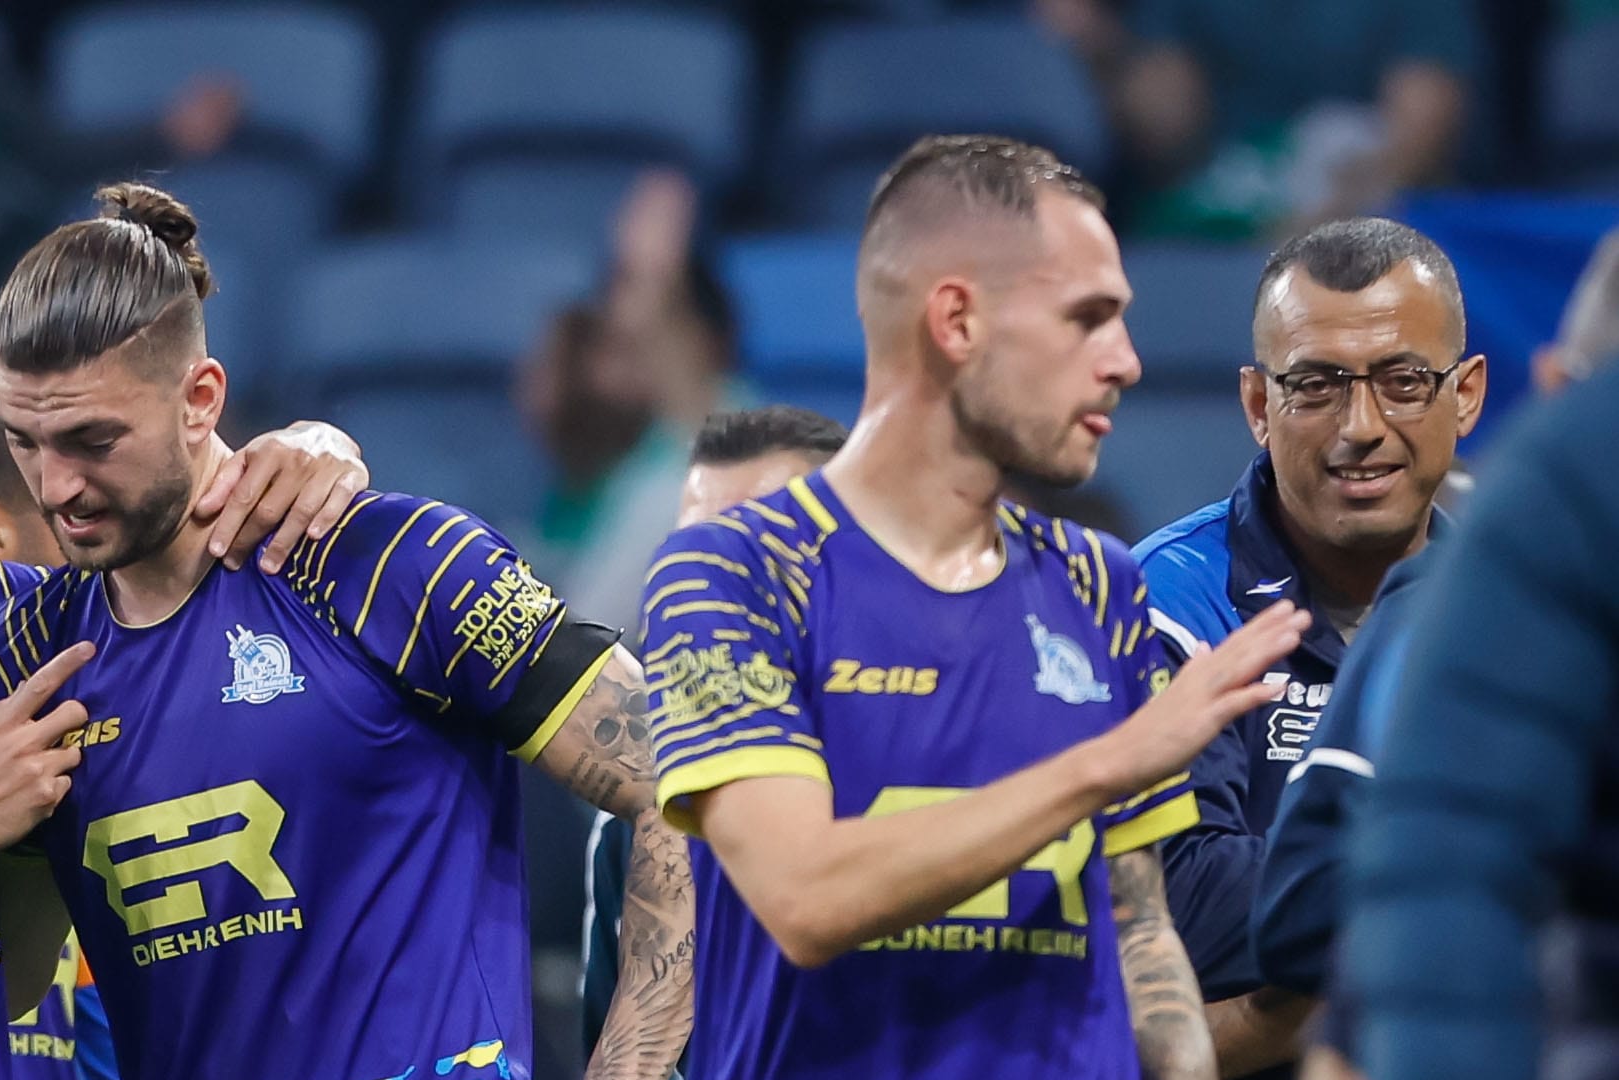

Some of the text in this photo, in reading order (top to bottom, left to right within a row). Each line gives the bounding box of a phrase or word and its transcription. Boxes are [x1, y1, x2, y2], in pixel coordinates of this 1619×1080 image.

[454, 566, 522, 639] TOPLINE
[823, 659, 939, 696] Zeus
[1262, 672, 1334, 708] Zeu
